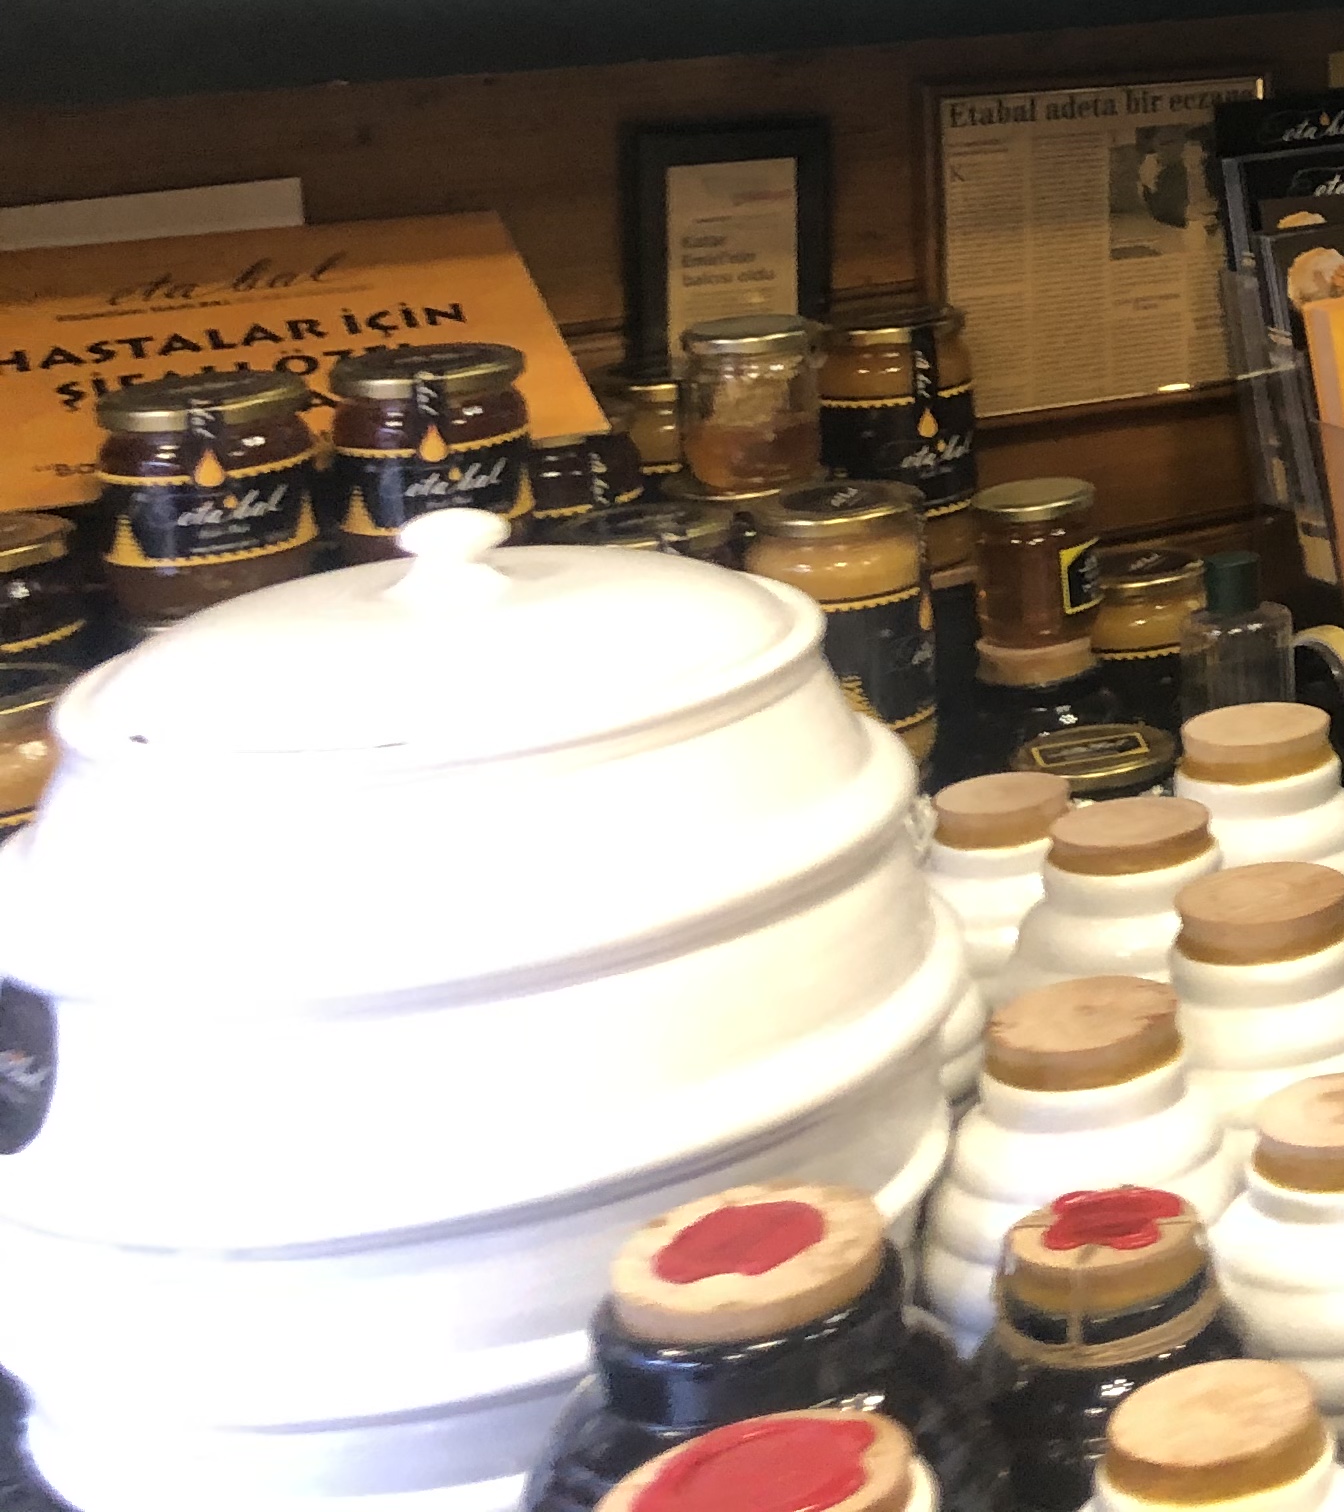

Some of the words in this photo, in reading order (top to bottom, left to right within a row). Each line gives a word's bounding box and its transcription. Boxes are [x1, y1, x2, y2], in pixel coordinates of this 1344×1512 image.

[948, 97, 1038, 129] Etabal
[1045, 93, 1119, 121] adeta
[1125, 88, 1164, 114] bir
[0, 317, 328, 373] HASTALAR
[339, 301, 468, 338] İÇİN
